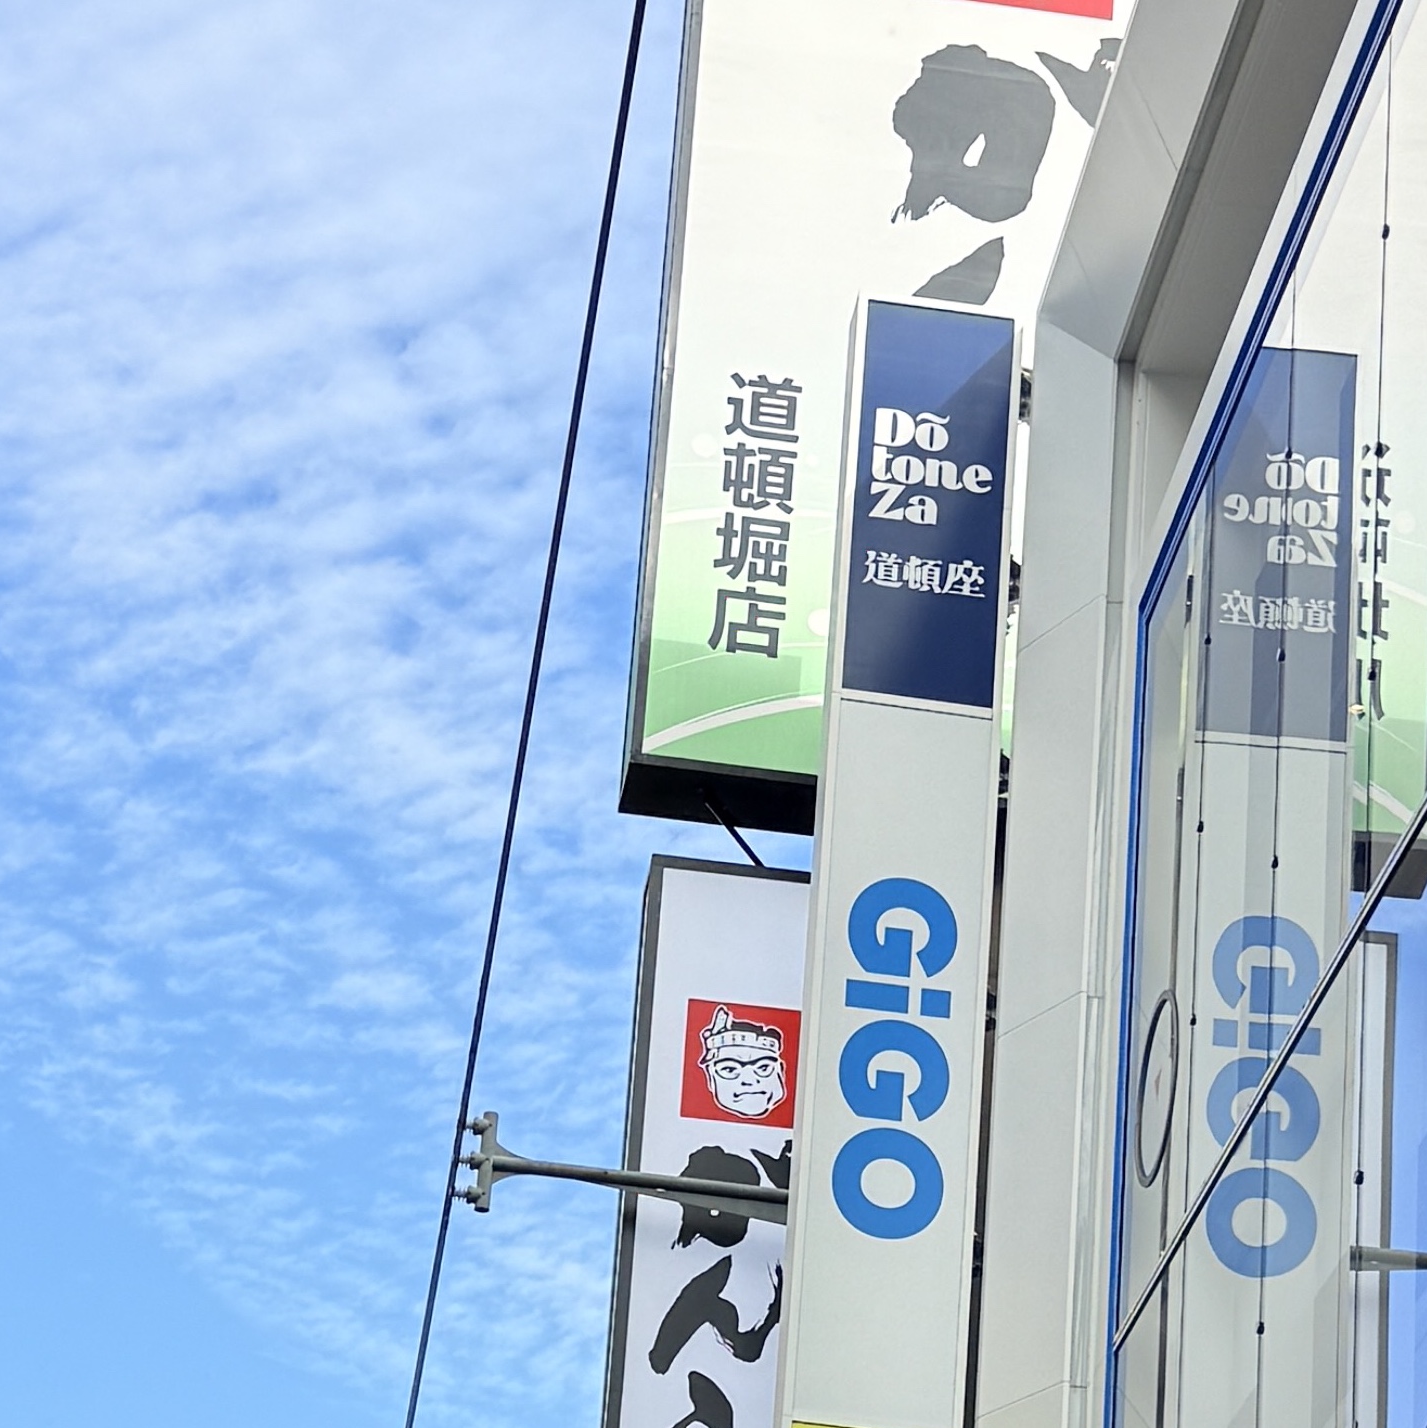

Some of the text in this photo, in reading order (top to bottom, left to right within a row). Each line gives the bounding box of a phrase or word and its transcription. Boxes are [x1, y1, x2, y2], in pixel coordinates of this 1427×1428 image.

[872, 446, 993, 494] tone
[708, 373, 803, 659] 道頓堀店
[868, 481, 938, 526] Za
[861, 550, 986, 598] 道頓座
[832, 877, 958, 1240] GiGO
